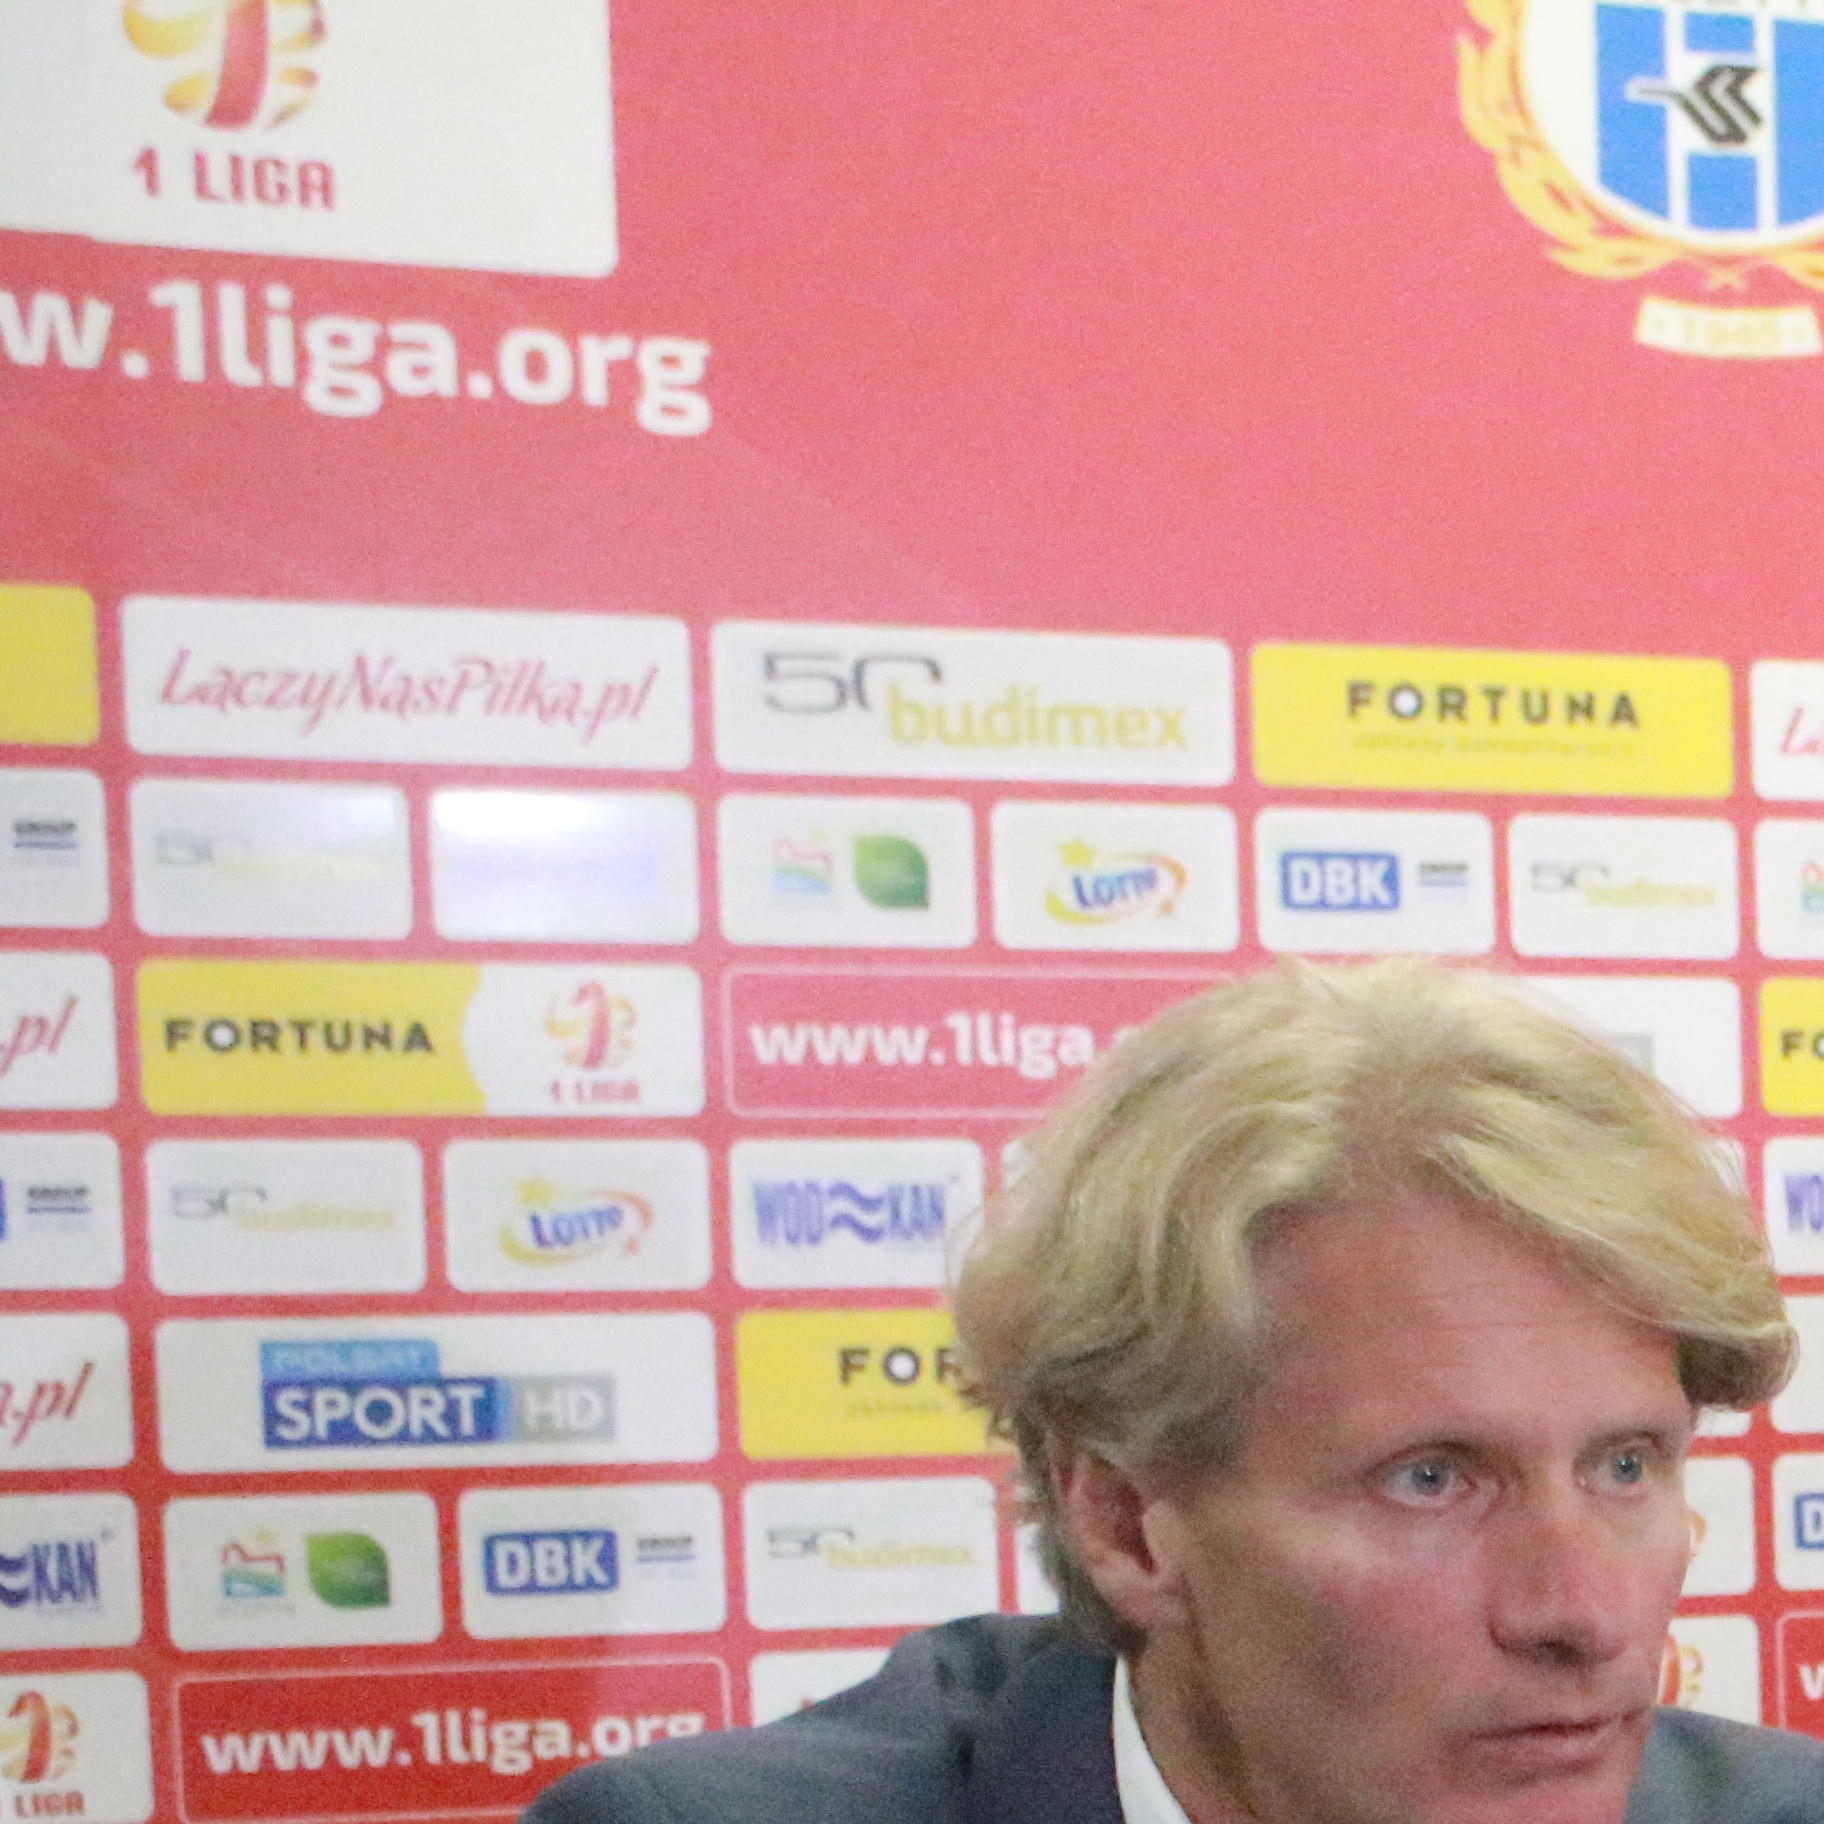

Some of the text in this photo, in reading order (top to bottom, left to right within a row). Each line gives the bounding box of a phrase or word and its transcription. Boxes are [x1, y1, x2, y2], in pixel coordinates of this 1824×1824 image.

[135, 147, 337, 212] 1 LIGA
[886, 682, 1189, 753] budimex
[1346, 678, 1641, 732] FORTUNA
[1285, 856, 1392, 907] DBK
[164, 1016, 435, 1056] FORTUNA
[749, 1010, 1118, 1082] www.1liga.
[530, 1202, 624, 1251] LOTTO
[273, 1385, 605, 1443] SPORT HD
[494, 1534, 610, 1592] DBK
